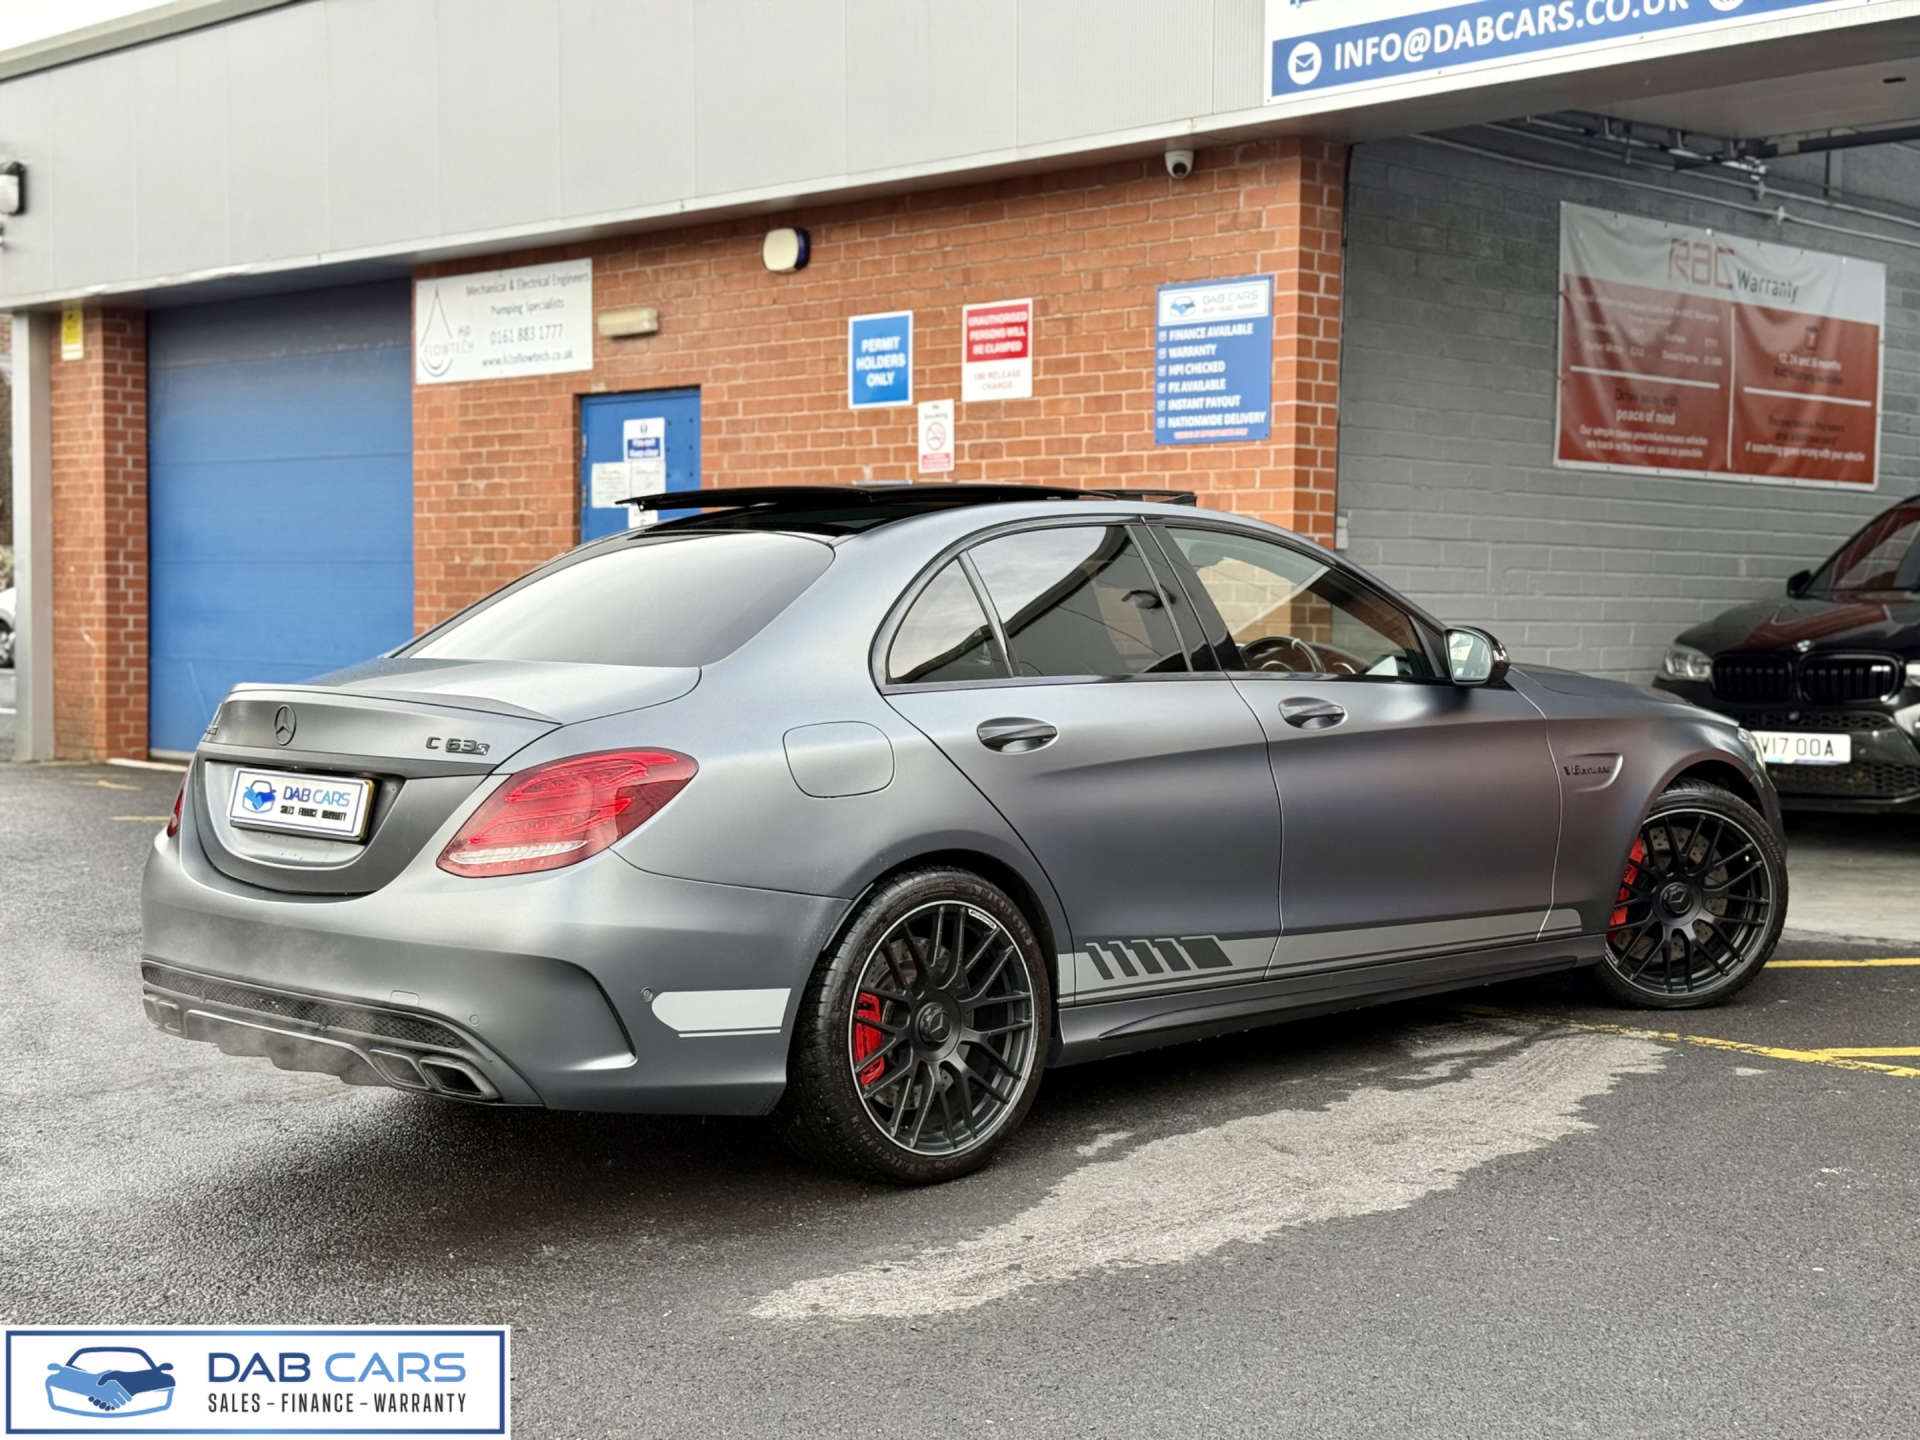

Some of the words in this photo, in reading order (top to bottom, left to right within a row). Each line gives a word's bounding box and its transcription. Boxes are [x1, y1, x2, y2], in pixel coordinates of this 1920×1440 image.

[1667, 237, 1736, 290] RAC
[1736, 267, 1799, 304] Warranty
[466, 282, 506, 296] Mechanical
[517, 274, 550, 290] Electrical
[539, 323, 563, 340] 1777
[1169, 326, 1206, 341] FINANCE
[1206, 322, 1254, 338] AVAILABLE
[862, 336, 901, 352] PERMIT
[1168, 344, 1217, 359] WARRANTY
[856, 353, 906, 371] HOLDERS
[1184, 360, 1227, 375] CHECKED
[866, 371, 895, 387] ONLY
[1181, 378, 1227, 393] AVAILABLE
[1168, 397, 1204, 411] INSTANT
[1205, 394, 1242, 409] PAYOUT
[1168, 414, 1223, 428] NATIONWIDE
[1223, 411, 1267, 426] DELIVERY
[426, 737, 441, 749] C
[283, 786, 311, 803] DAB
[312, 790, 351, 807] CARS
